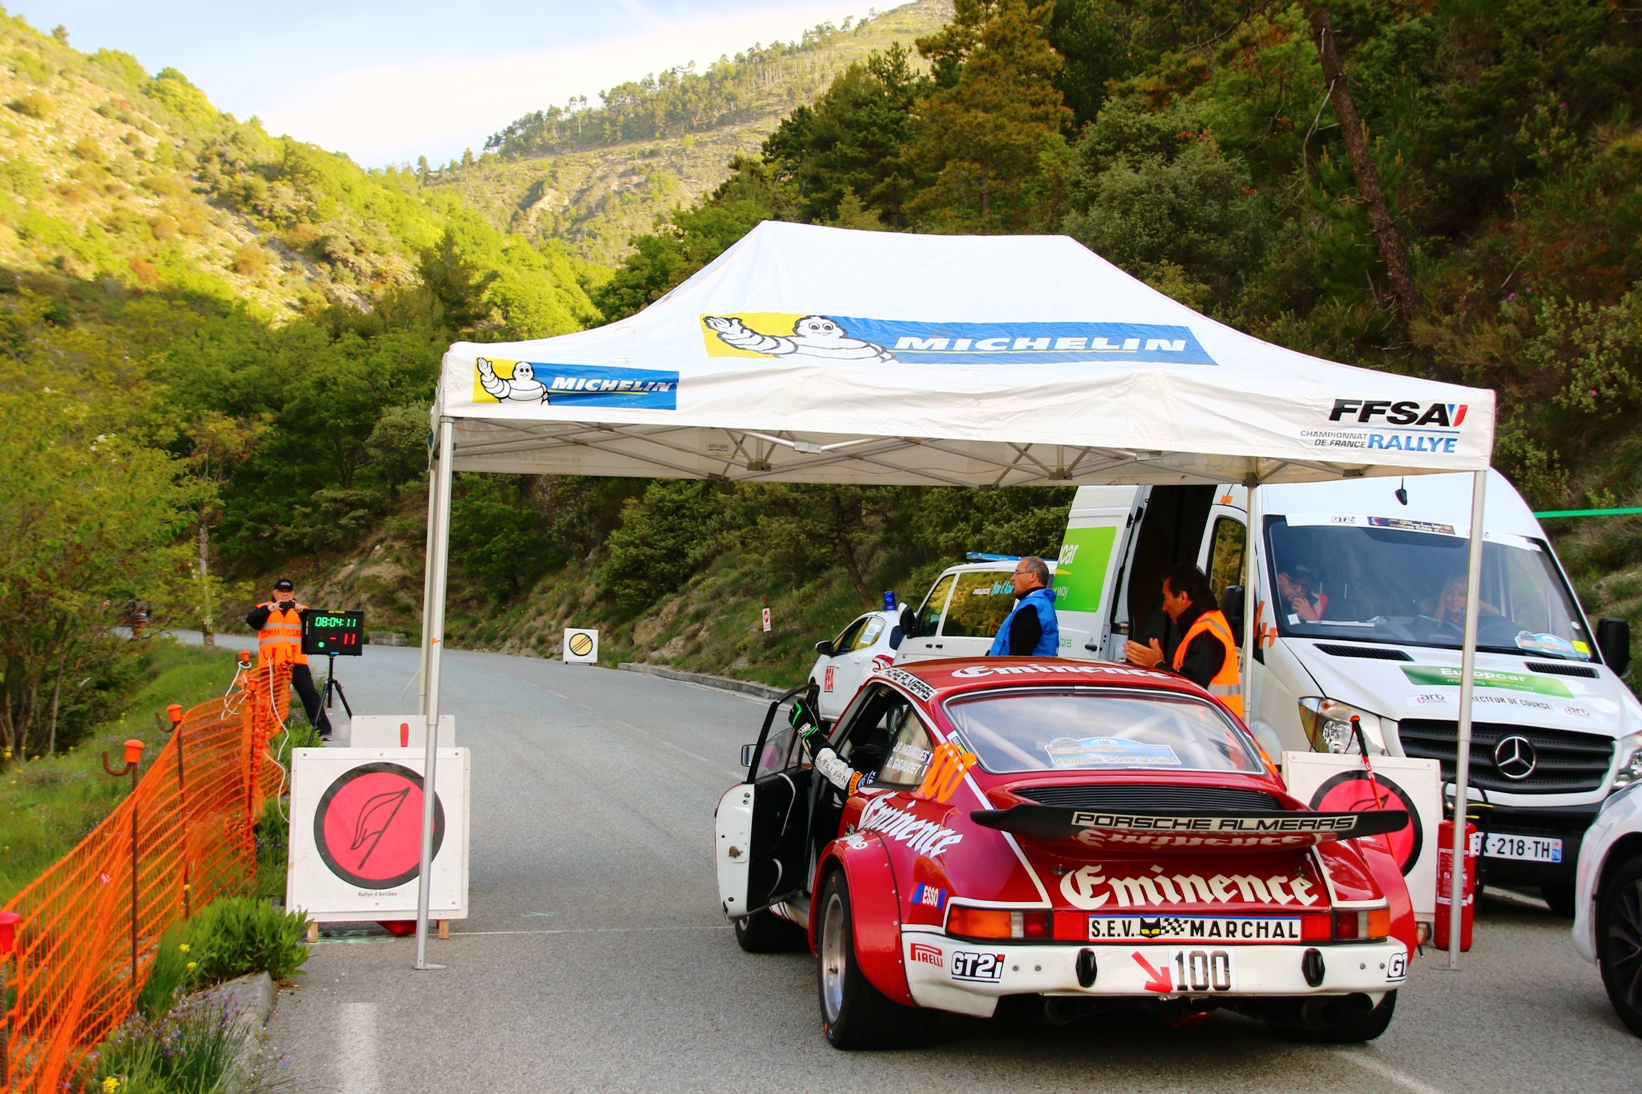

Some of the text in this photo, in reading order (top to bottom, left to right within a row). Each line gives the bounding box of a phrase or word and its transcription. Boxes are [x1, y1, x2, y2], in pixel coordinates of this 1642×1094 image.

[894, 336, 1187, 352] MICHELIN
[551, 376, 673, 393] MICHELIN
[1328, 398, 1451, 427] FFSA
[1300, 430, 1369, 440] CHAMPIONNAT
[1314, 438, 1367, 449] DE FRANCE
[1367, 433, 1458, 453] RALLYE
[1058, 544, 1079, 565] car
[315, 616, 357, 628] 08:04:11
[951, 663, 1174, 679] Eminence
[1440, 668, 1526, 682] Euopcar
[857, 790, 964, 859] Eminence
[1074, 812, 1354, 831] PORSCHE ALMERAS
[922, 885, 939, 907] ESSO
[1059, 864, 1320, 910] Eminence
[1190, 920, 1299, 939] MARCHAL
[910, 943, 944, 968] PIRELLI
[951, 951, 1005, 979] GT2i
[1174, 950, 1231, 992] 100
